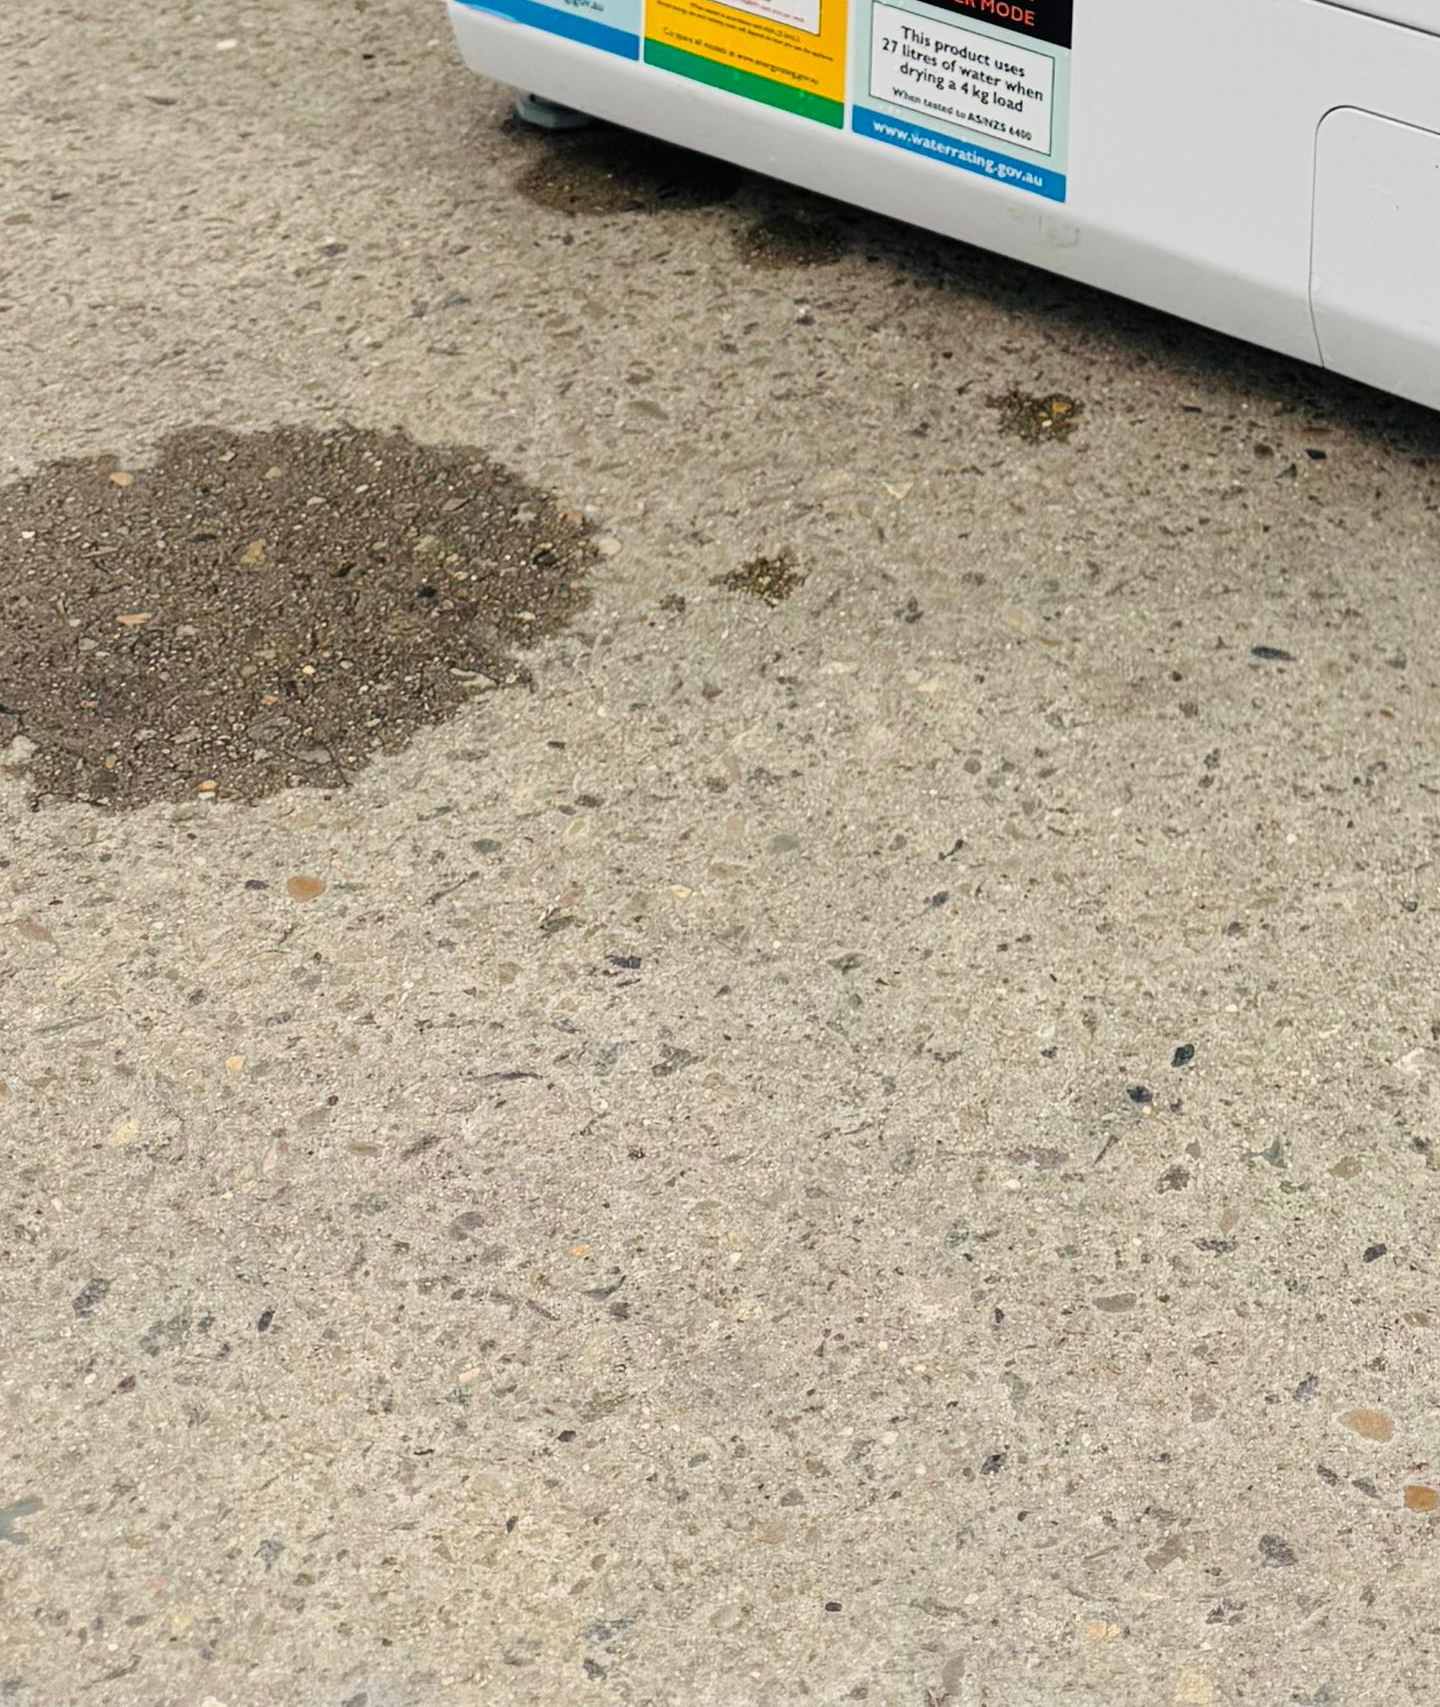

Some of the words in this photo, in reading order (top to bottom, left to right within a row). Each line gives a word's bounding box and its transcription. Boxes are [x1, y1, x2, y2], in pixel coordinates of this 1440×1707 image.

[882, 38, 899, 53] 27
[902, 44, 937, 65] litres
[942, 61, 956, 70] of
[960, 65, 1001, 86] water
[1006, 80, 1043, 101] when
[902, 26, 930, 47] This
[935, 41, 990, 66] product
[995, 60, 1025, 77] uses
[893, 87, 921, 104] When
[923, 97, 953, 115] tested
[956, 107, 965, 119] to
[967, 112, 1006, 134] AS/NZS
[900, 63, 944, 90] drying
[949, 80, 956, 90] a
[961, 81, 968, 93] 4
[972, 86, 988, 104] kg
[993, 92, 1023, 112] load
[873, 121, 1042, 187] www.waterrating.gov.au
